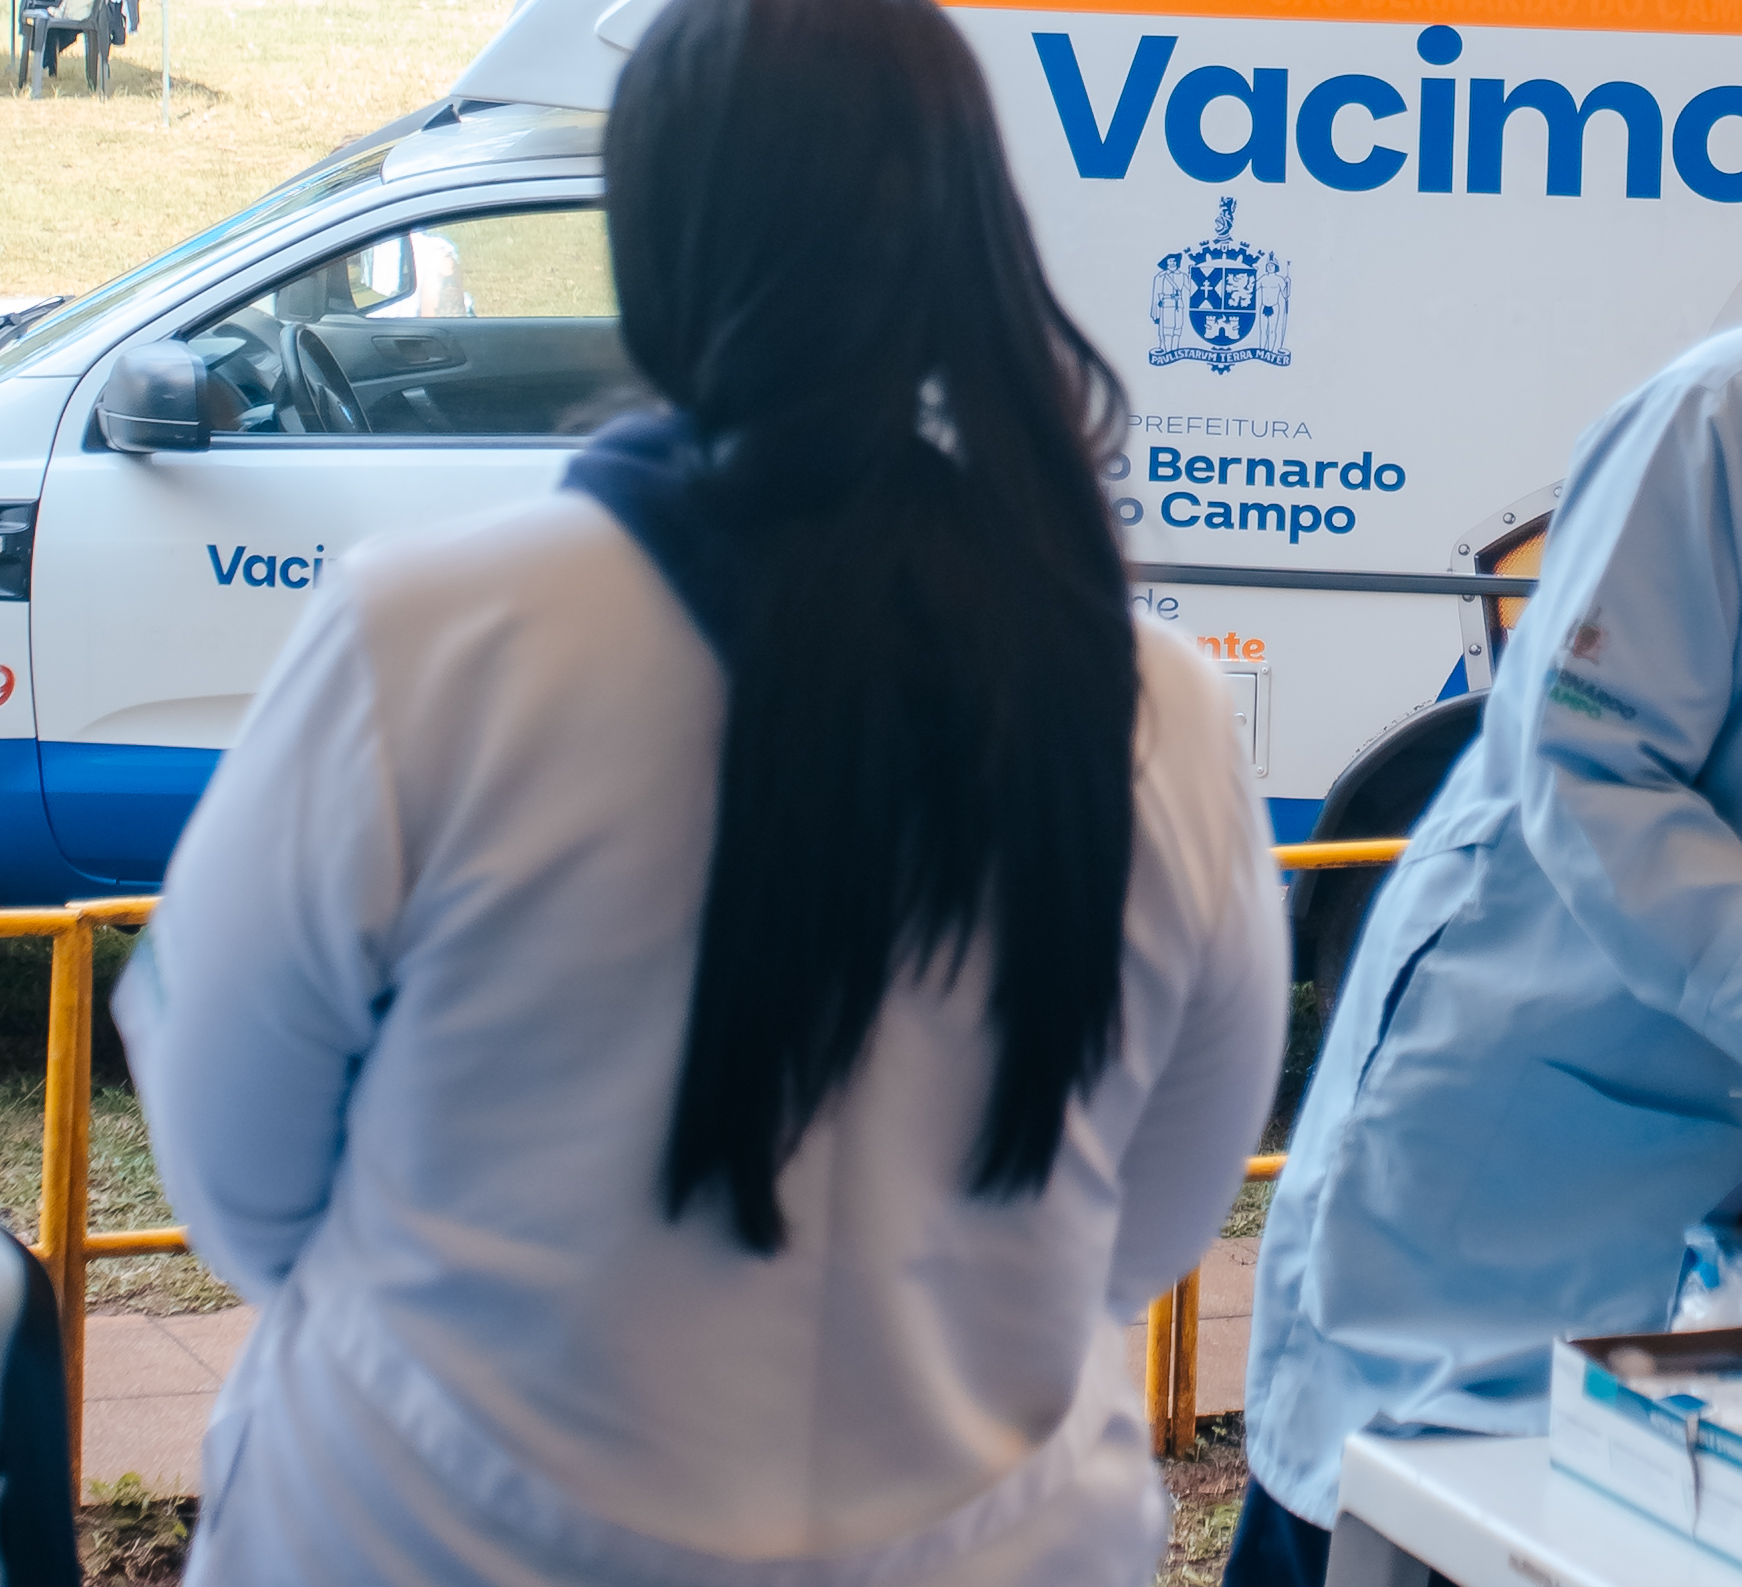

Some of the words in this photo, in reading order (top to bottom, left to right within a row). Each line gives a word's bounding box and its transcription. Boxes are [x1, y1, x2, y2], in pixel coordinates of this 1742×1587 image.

[1219, 350, 1253, 363] TERRA
[1254, 349, 1290, 365] MATER
[1148, 445, 1407, 492] Bernardo
[1160, 491, 1356, 545] Campo
[206, 543, 337, 590] Vaci
